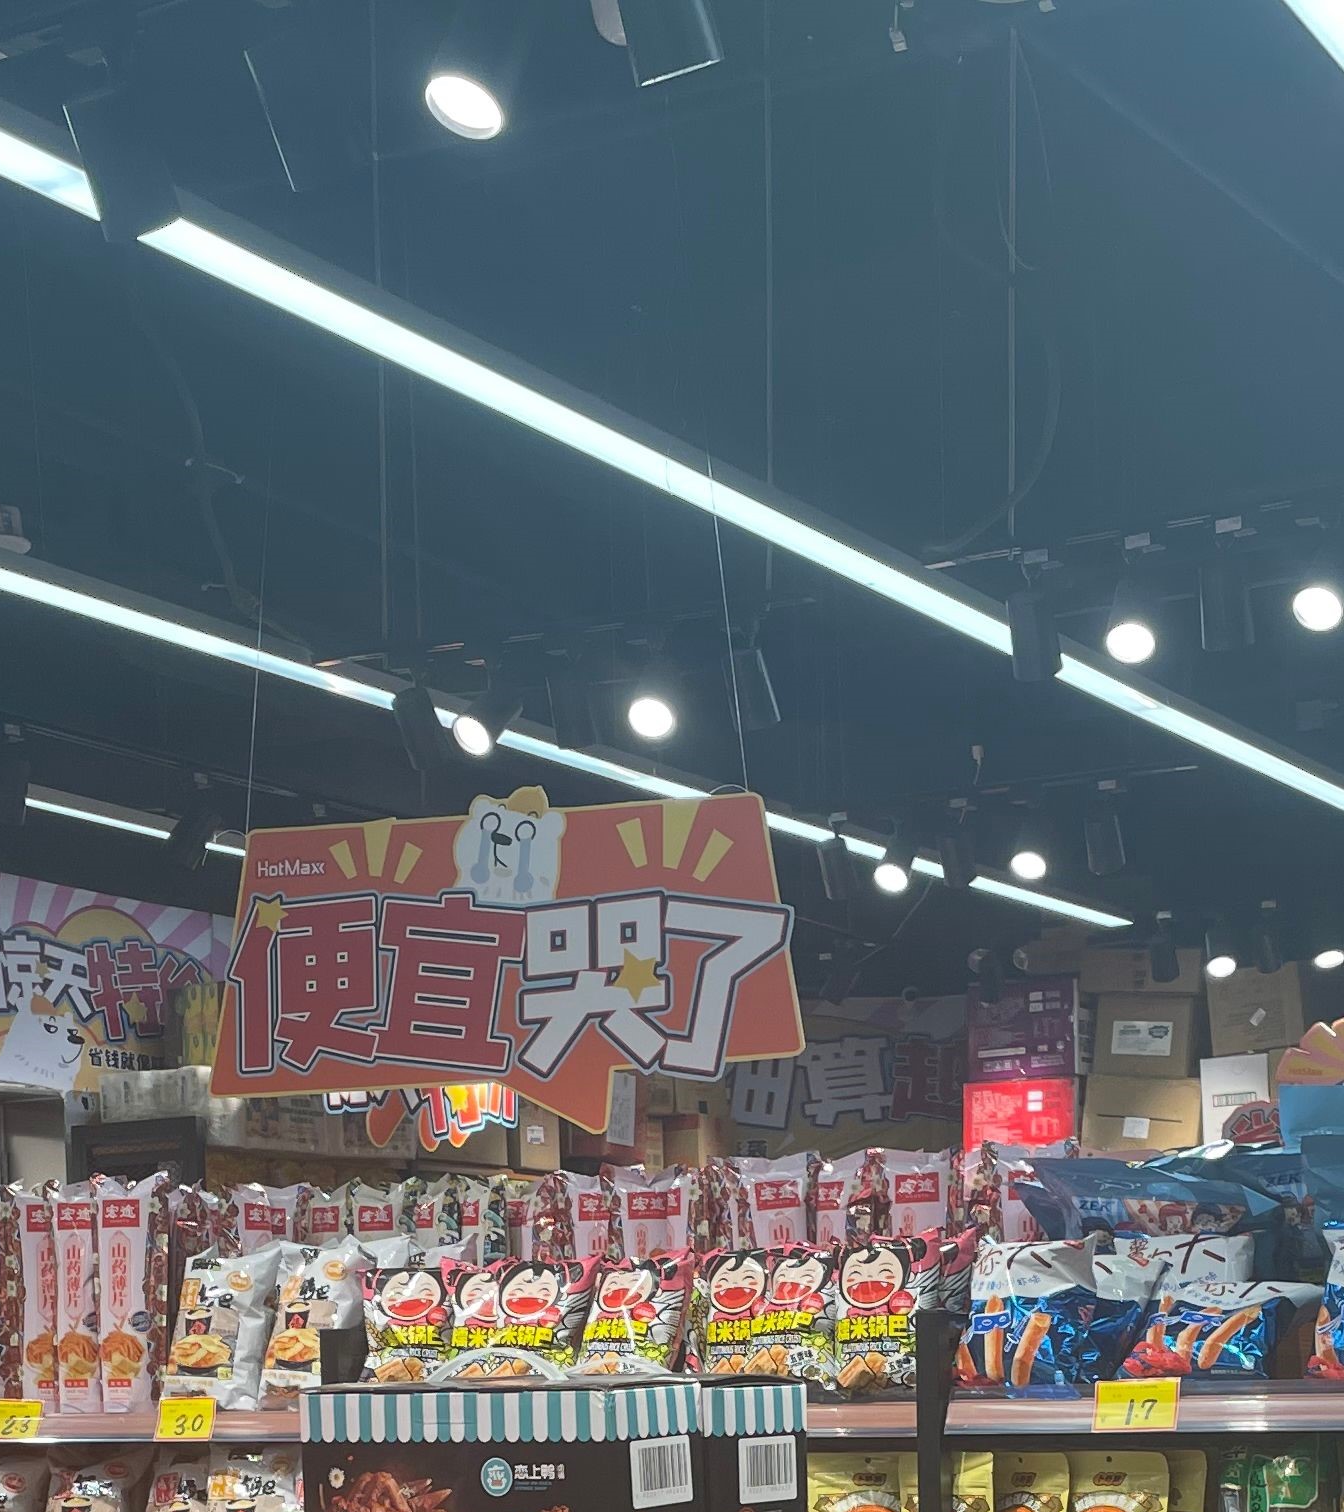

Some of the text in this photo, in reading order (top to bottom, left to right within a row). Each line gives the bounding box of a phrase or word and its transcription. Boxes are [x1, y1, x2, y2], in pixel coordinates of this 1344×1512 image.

[228, 888, 794, 1081] 便宜哭了
[174, 1414, 205, 1436] 3.0
[1124, 1398, 1157, 1426] 1.7
